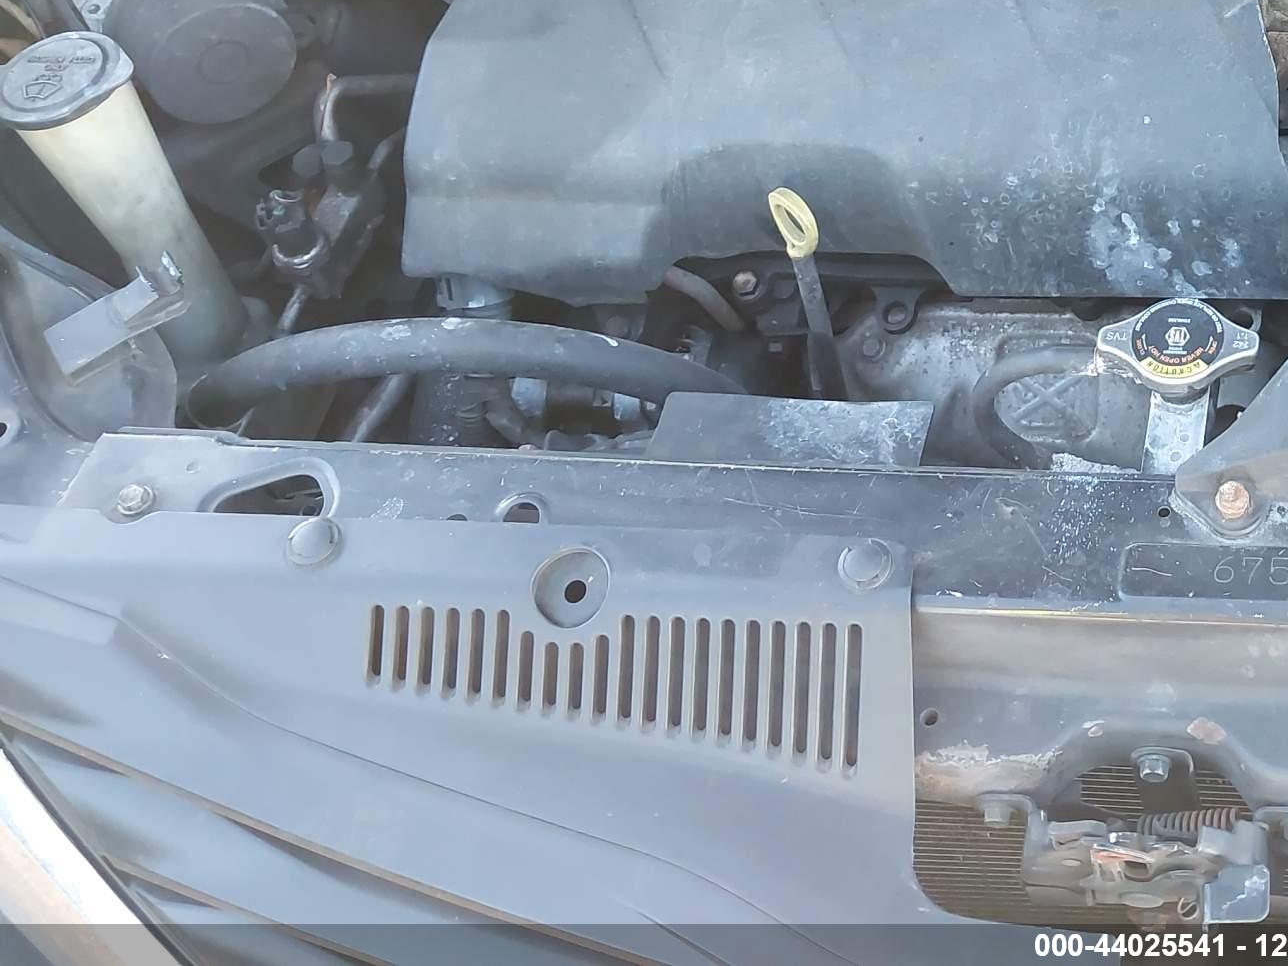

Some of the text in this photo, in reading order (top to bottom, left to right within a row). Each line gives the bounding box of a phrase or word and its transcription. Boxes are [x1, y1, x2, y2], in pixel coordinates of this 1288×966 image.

[1105, 331, 1128, 341] TVS
[1168, 330, 1186, 344] TVS
[1160, 354, 1181, 364] OPEN
